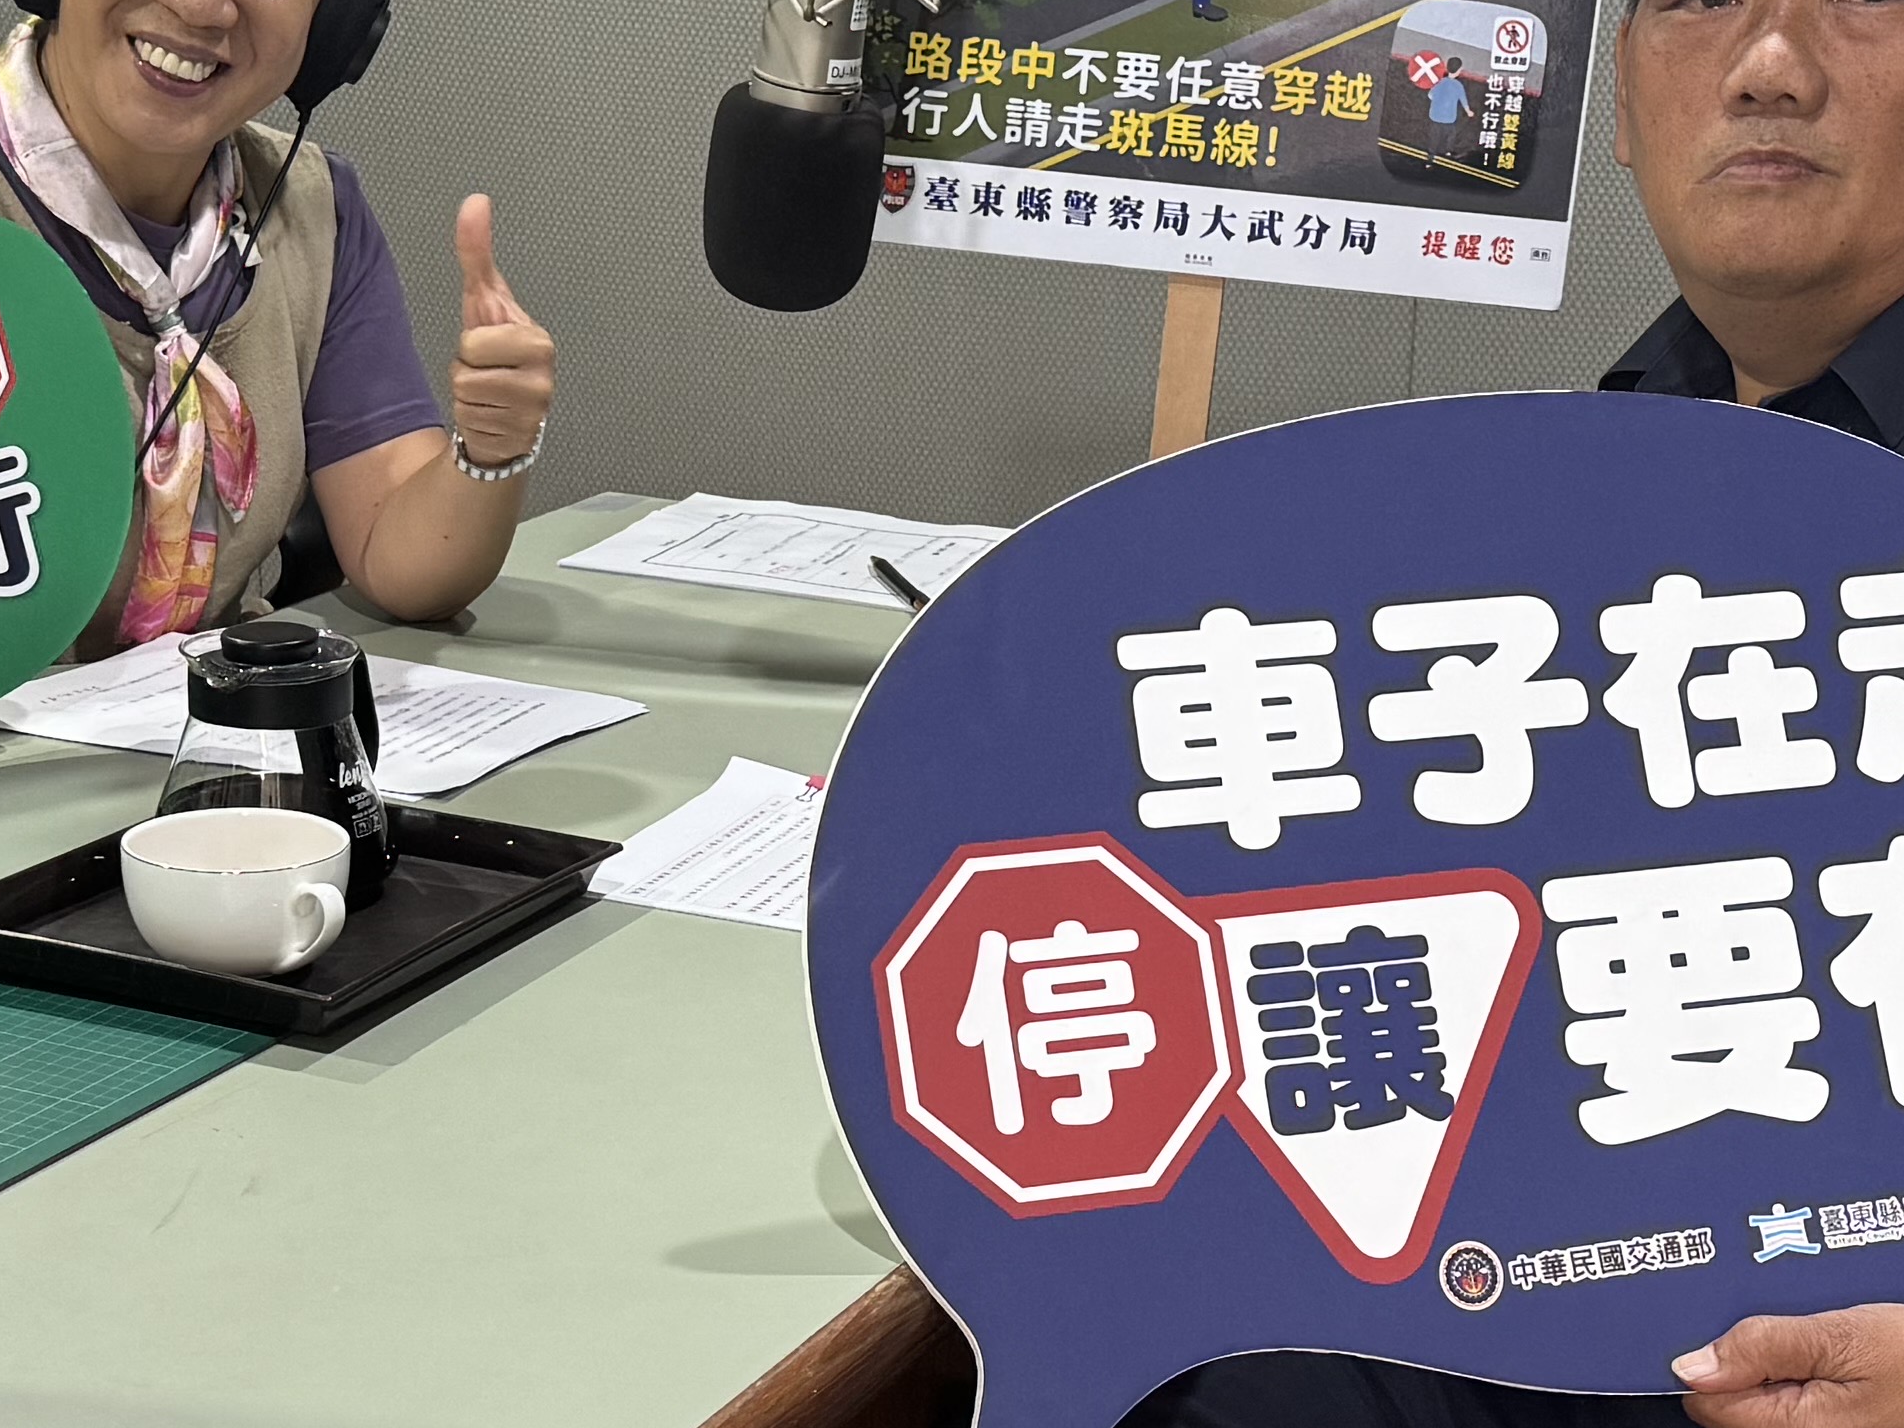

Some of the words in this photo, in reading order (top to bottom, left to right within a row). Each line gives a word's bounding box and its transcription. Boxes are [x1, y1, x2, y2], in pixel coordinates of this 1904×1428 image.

[905, 31, 1374, 121] 路段中不要任意穿越
[901, 86, 1281, 169] 行人請走斑馬線!
[1496, 76, 1526, 170] 穿越雙黃線
[924, 176, 1377, 256] 臺東縣警察局大武分局
[1422, 230, 1515, 266] 提醒您
[1512, 1231, 1712, 1287] 中華民國交通部
